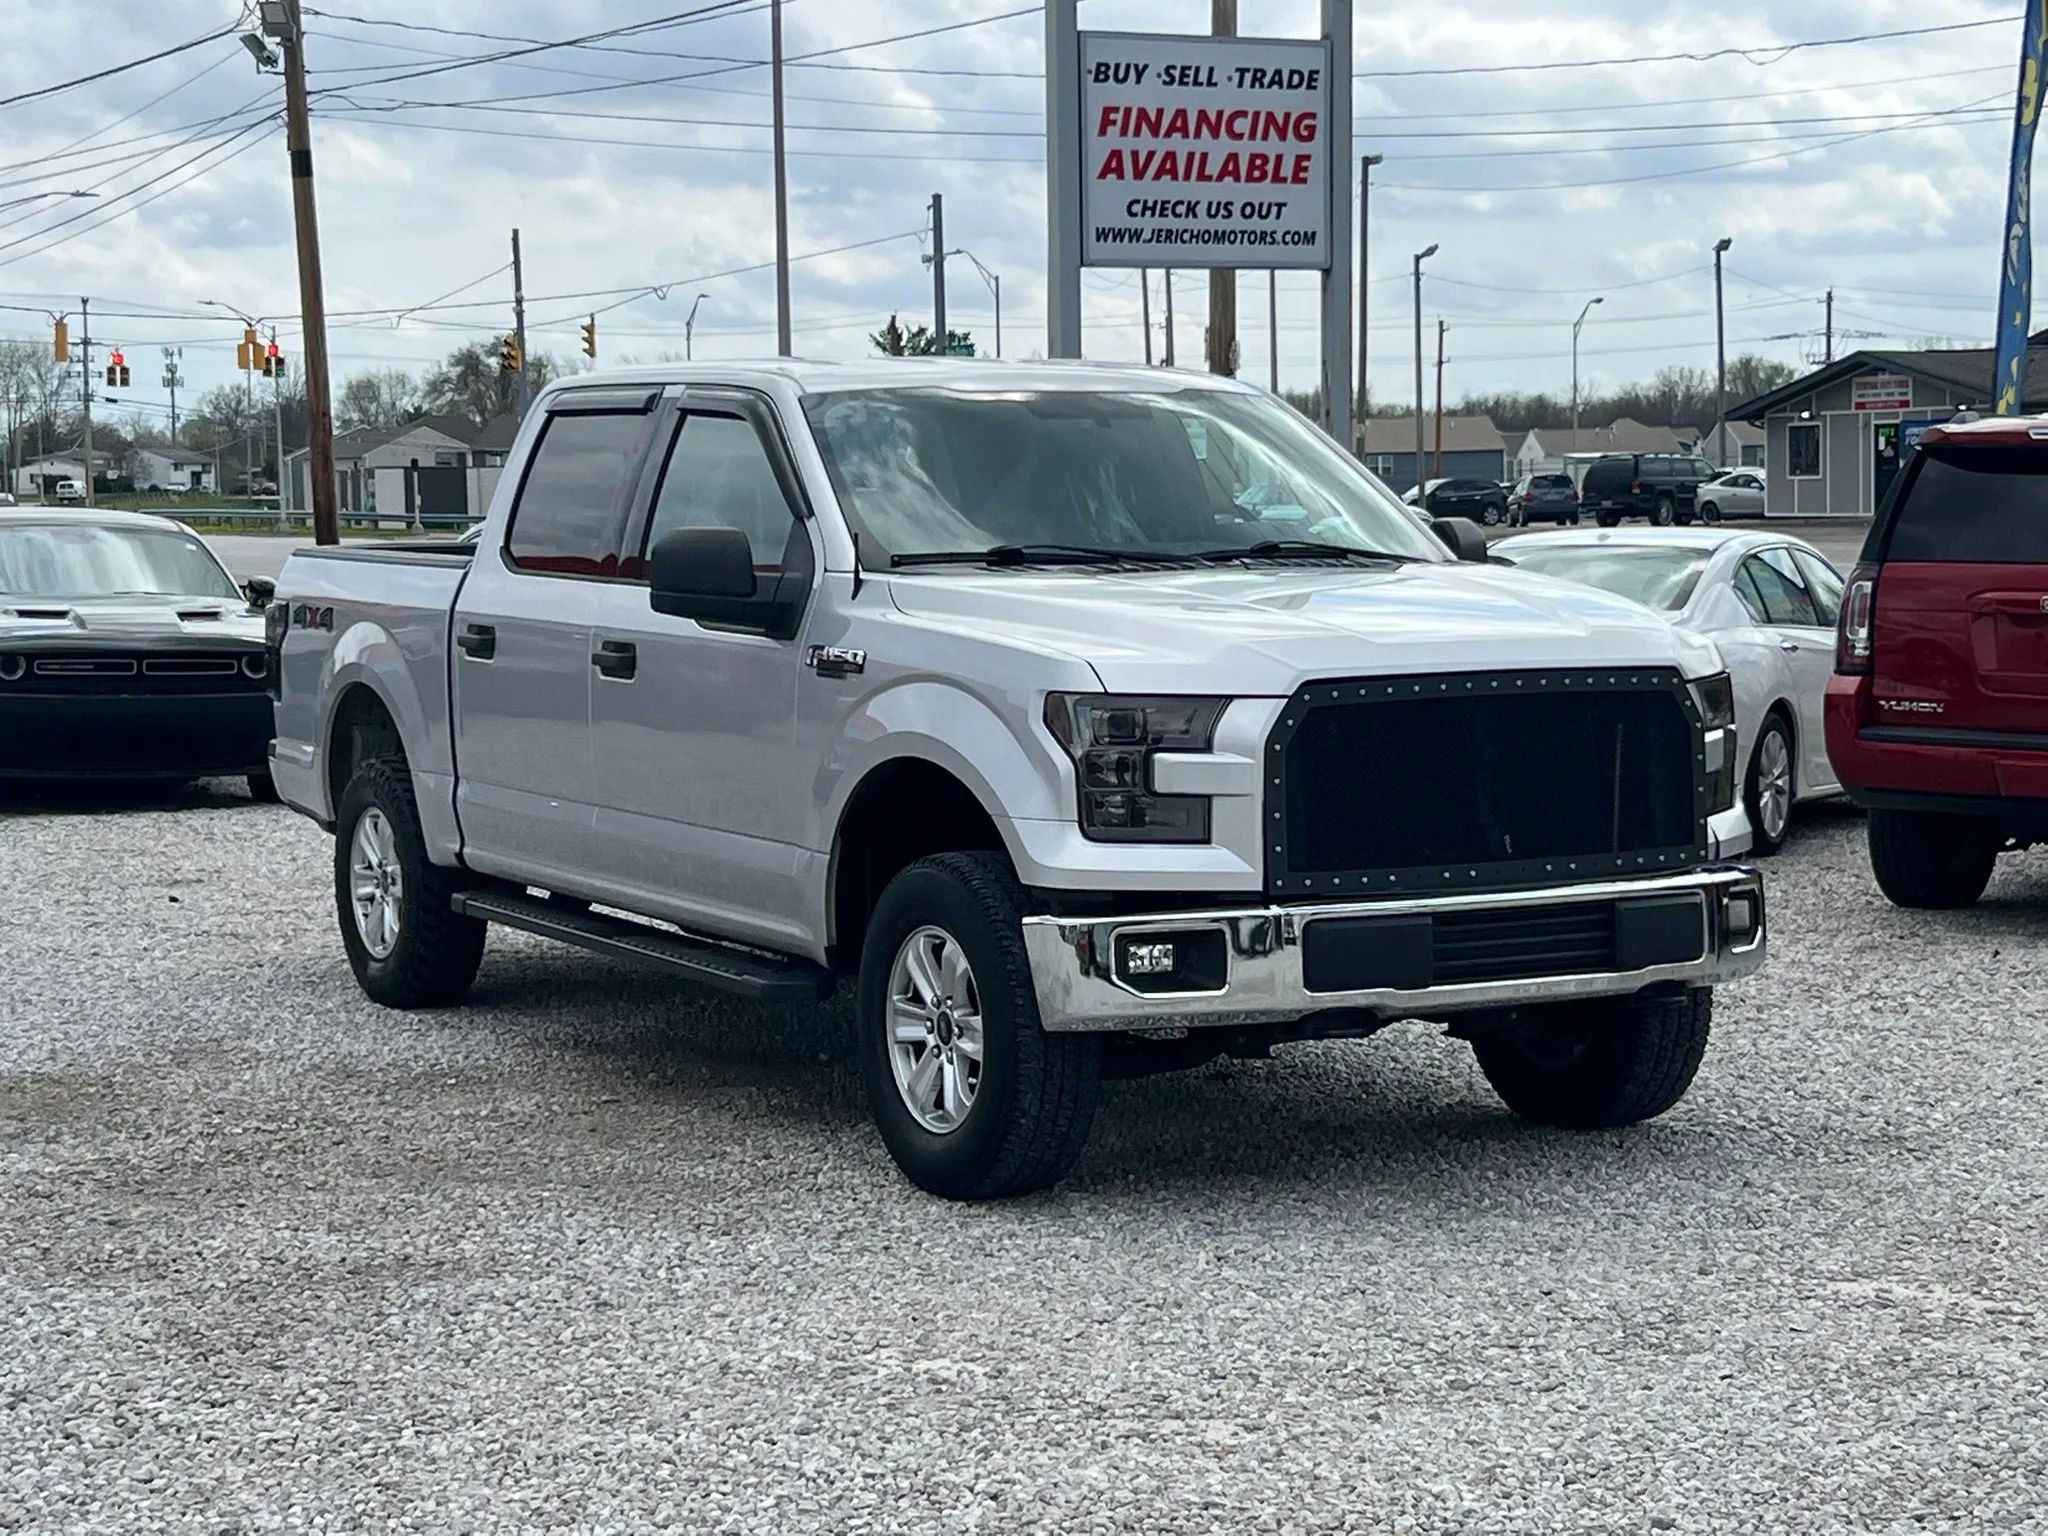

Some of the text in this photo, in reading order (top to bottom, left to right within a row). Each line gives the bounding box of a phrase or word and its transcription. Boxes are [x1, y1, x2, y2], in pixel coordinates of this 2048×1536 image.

[1098, 106, 1317, 142] FINANCING
[1097, 149, 1312, 184] AVAILABLE
[1126, 199, 1287, 220] CHECK US OUT
[1095, 227, 1317, 246] WWW.JERICHOMOTORS.COM
[1878, 700, 1944, 712] YUKON
